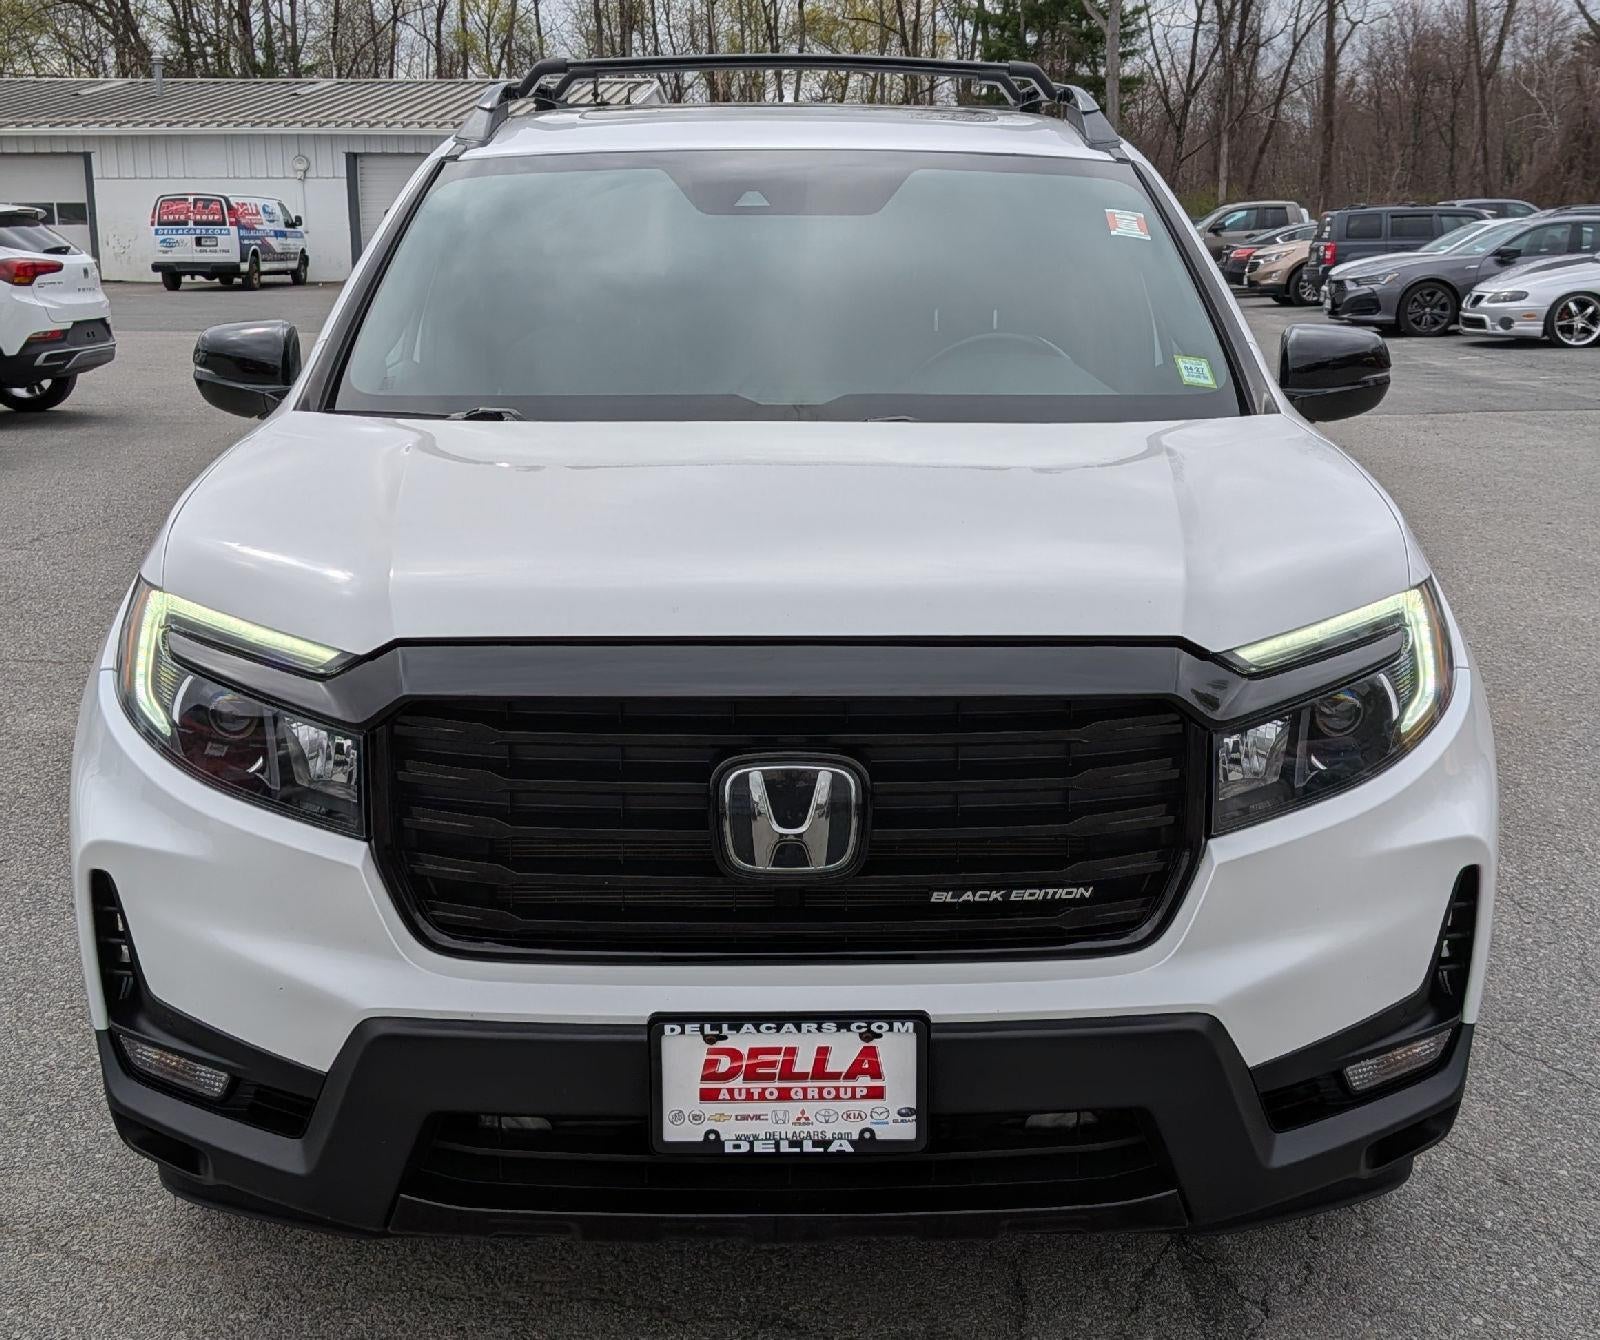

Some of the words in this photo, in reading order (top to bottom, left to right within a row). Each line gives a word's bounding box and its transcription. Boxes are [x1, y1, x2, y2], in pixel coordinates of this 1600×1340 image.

[161, 201, 221, 214] DELLA
[930, 890, 1007, 902] BLACK
[1009, 886, 1094, 901] EDITION
[664, 1022, 914, 1036] DELLACARS.COM
[700, 1045, 885, 1083] DELLA
[718, 1088, 778, 1100] AUTO
[790, 1087, 868, 1100] GROUP
[735, 1113, 768, 1122] GMC
[845, 1112, 864, 1120] KIA
[734, 1130, 852, 1141] www.DELLACARS.com
[724, 1140, 855, 1153] DELLA
